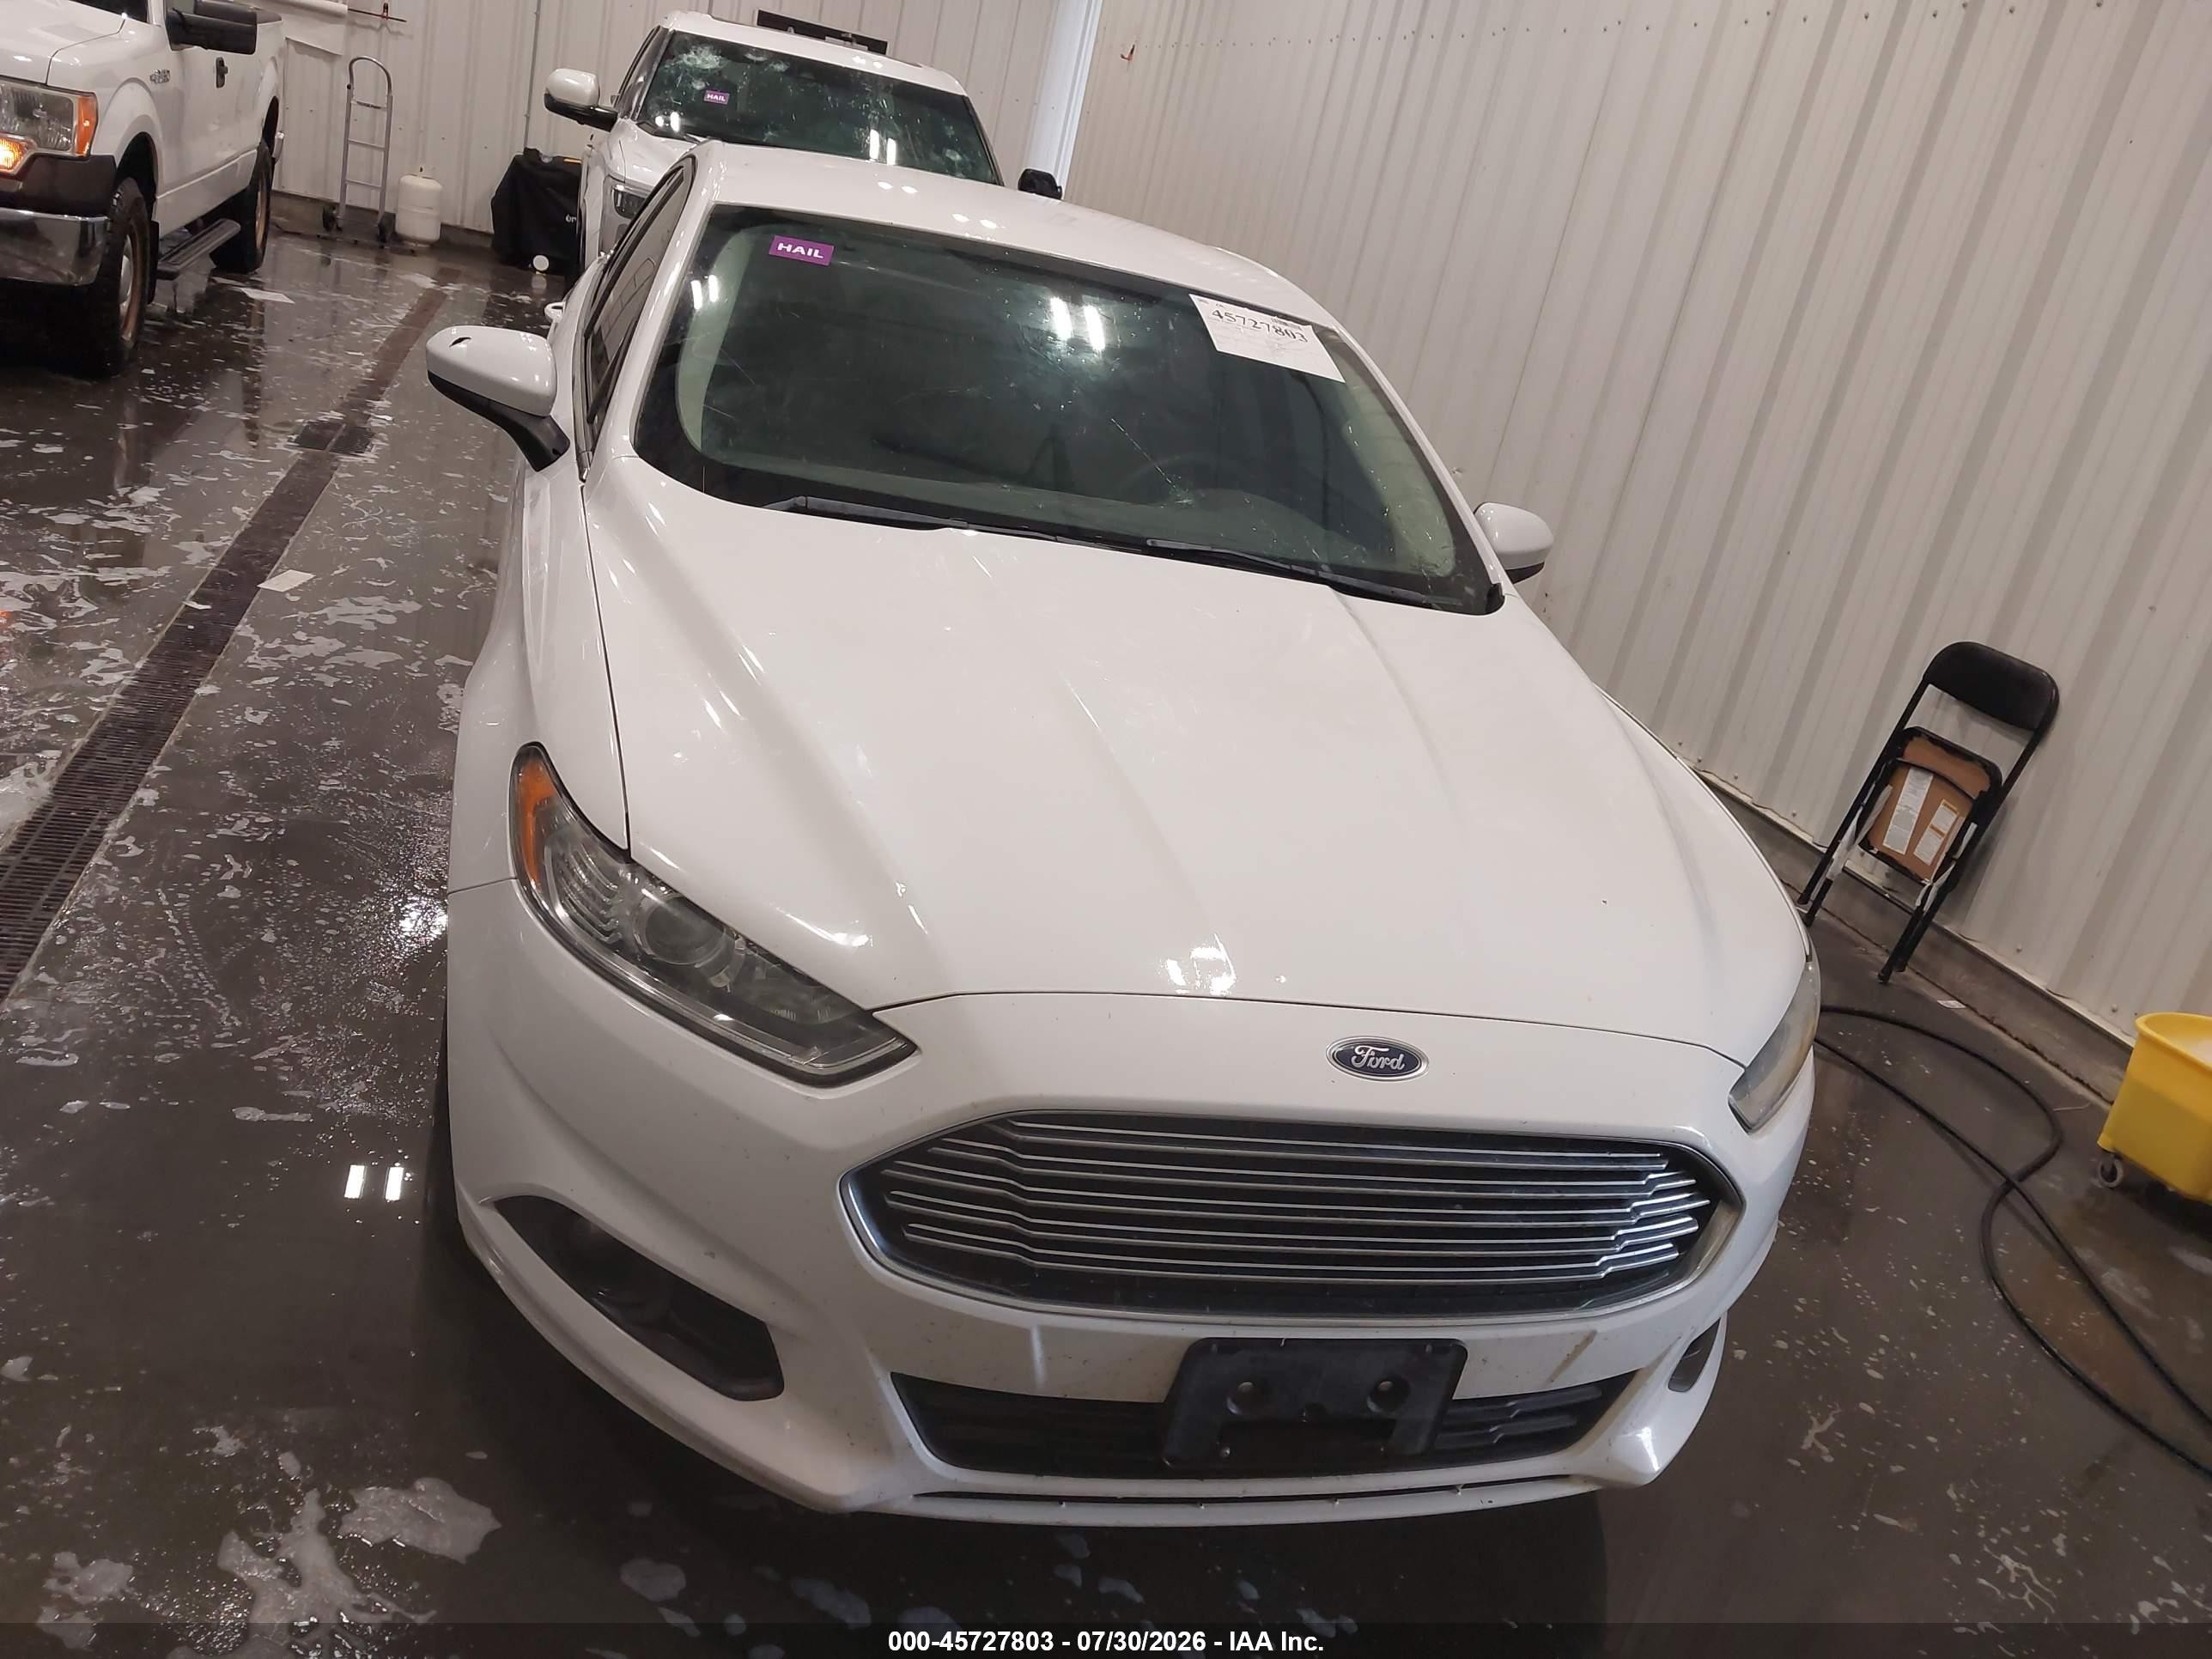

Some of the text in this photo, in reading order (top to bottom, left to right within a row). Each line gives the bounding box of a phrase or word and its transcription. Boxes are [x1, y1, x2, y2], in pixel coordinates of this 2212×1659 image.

[707, 93, 726, 102] HAIL
[776, 242, 824, 258] HAIL
[1212, 309, 1309, 343] 45727803
[1351, 1045, 1405, 1070] Ford
